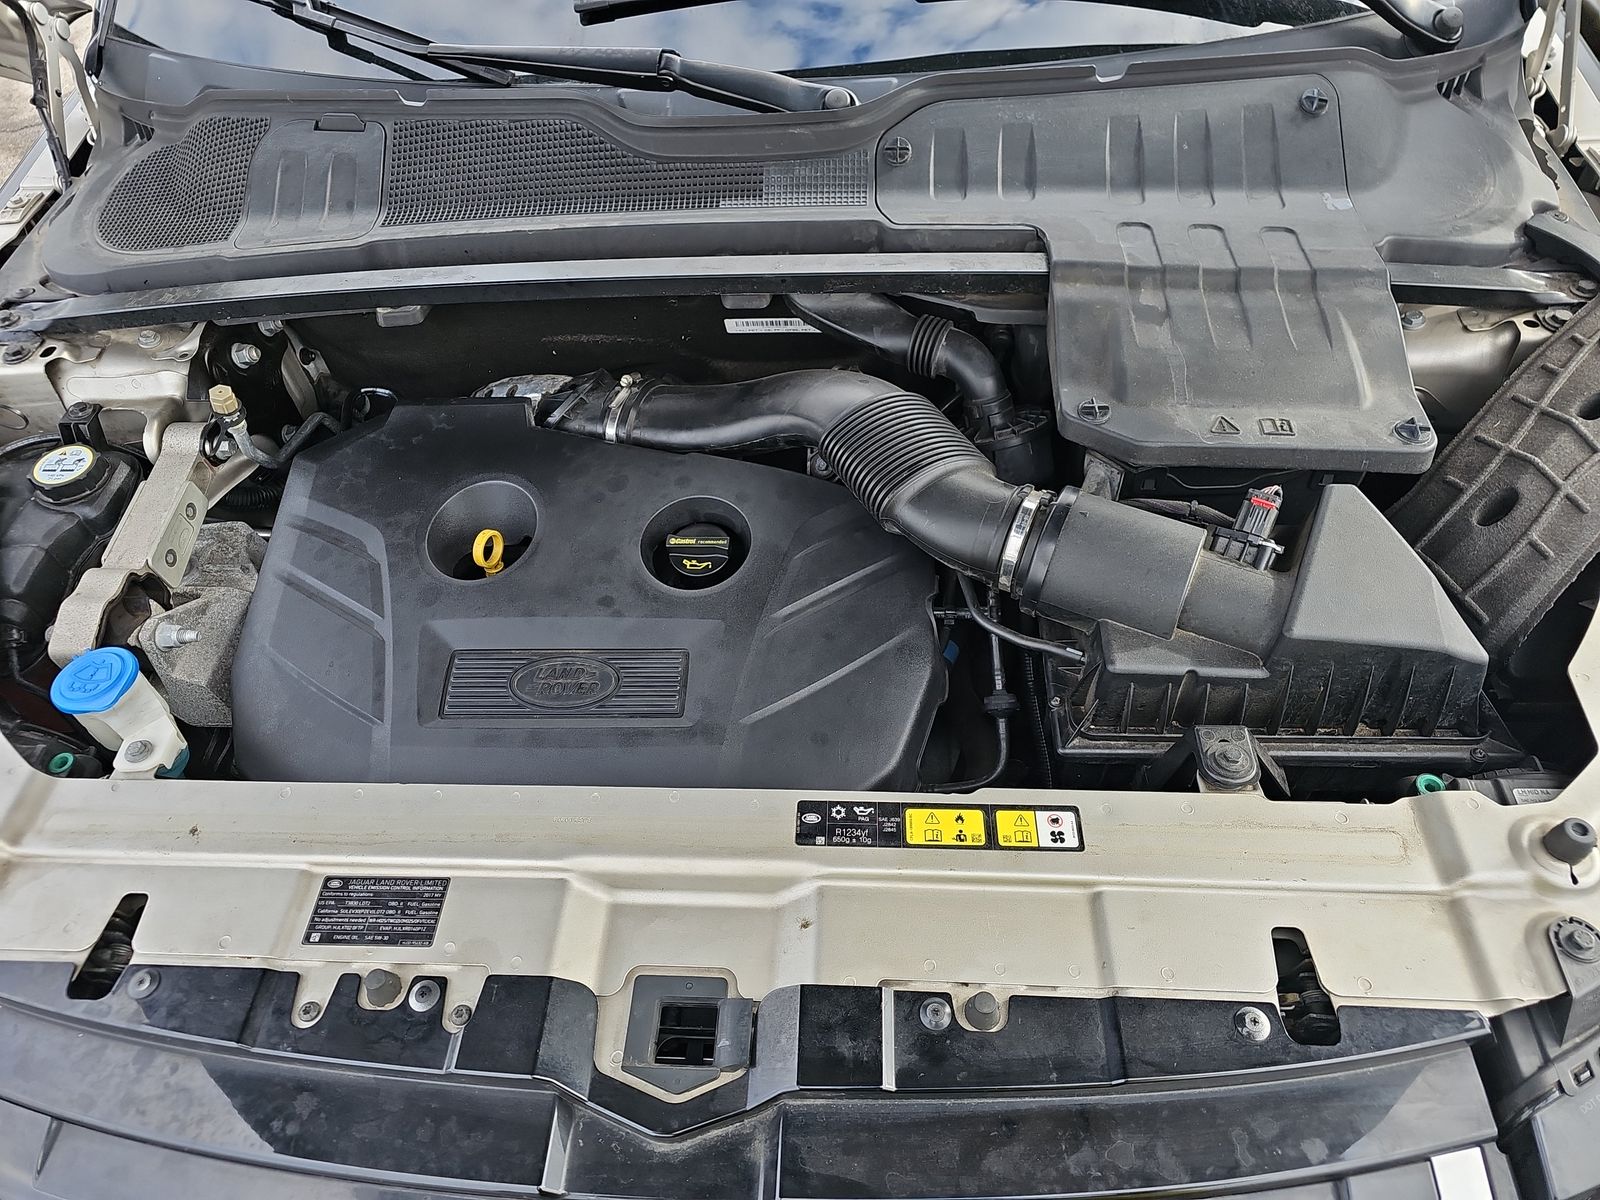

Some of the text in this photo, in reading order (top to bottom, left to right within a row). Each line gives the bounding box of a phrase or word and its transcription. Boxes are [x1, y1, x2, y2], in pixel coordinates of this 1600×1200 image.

[533, 667, 586, 682] LAND
[538, 681, 601, 697] ROVER
[835, 828, 868, 837] R1234yf
[1579, 1098, 1596, 1114] DOT
